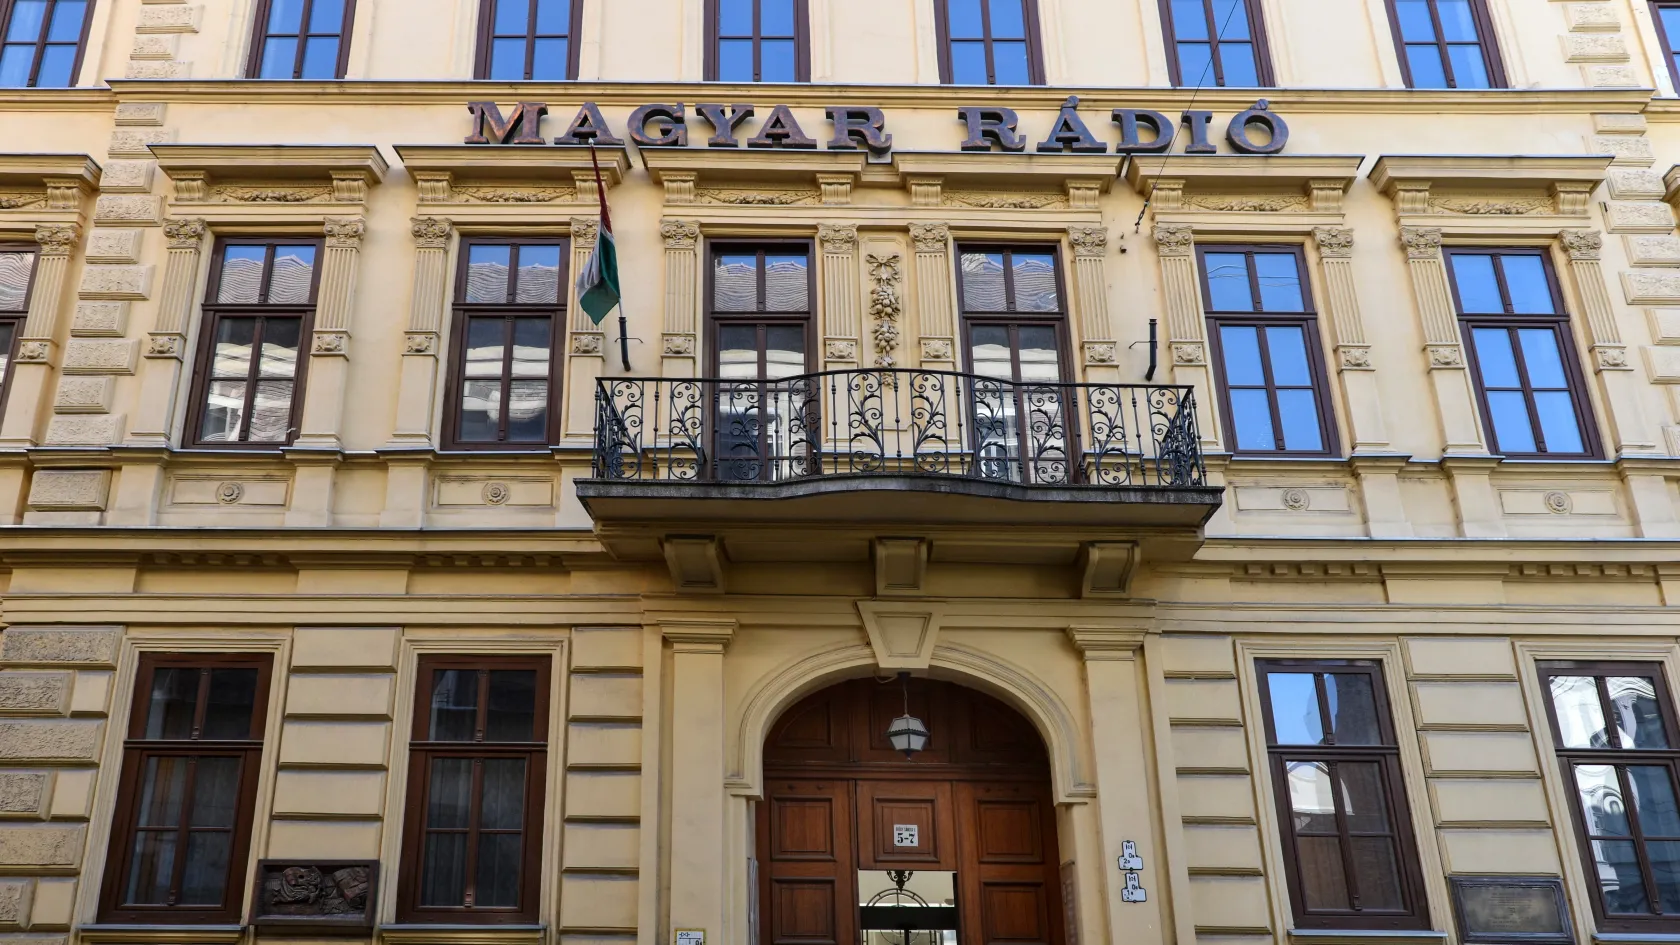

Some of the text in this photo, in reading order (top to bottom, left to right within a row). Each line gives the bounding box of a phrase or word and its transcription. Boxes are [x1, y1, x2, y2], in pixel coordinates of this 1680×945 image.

[464, 95, 1290, 154] MAGYAR RÁDIÓ
[897, 832, 915, 844] 5-7
